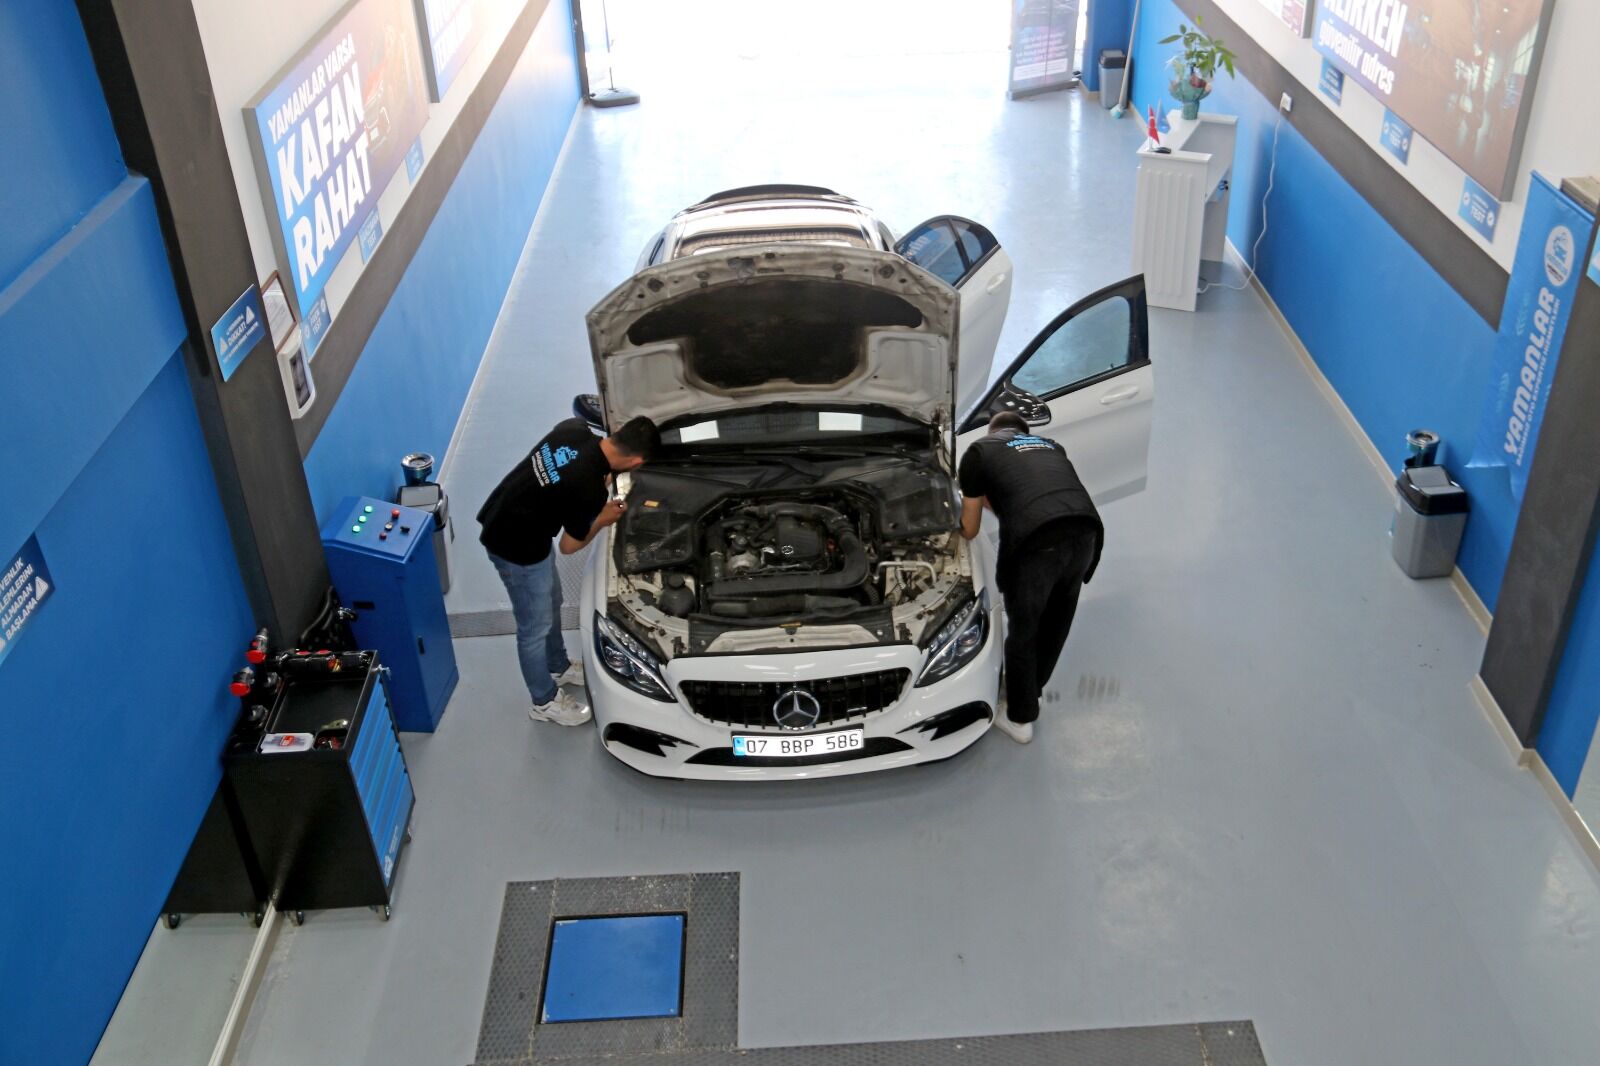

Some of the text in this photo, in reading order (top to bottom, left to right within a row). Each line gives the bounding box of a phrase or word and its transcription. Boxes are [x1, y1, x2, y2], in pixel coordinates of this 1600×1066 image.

[268, 32, 356, 145] YAMANLAR VARSA
[1361, 51, 1395, 95] adres
[277, 61, 365, 221] KAFAN
[292, 132, 372, 293] RAHAT
[1470, 203, 1486, 225] TEST
[1503, 287, 1555, 455] YAMANLAR
[2, 582, 33, 629] ALMADAN
[746, 733, 859, 754] 07 BBP 586
